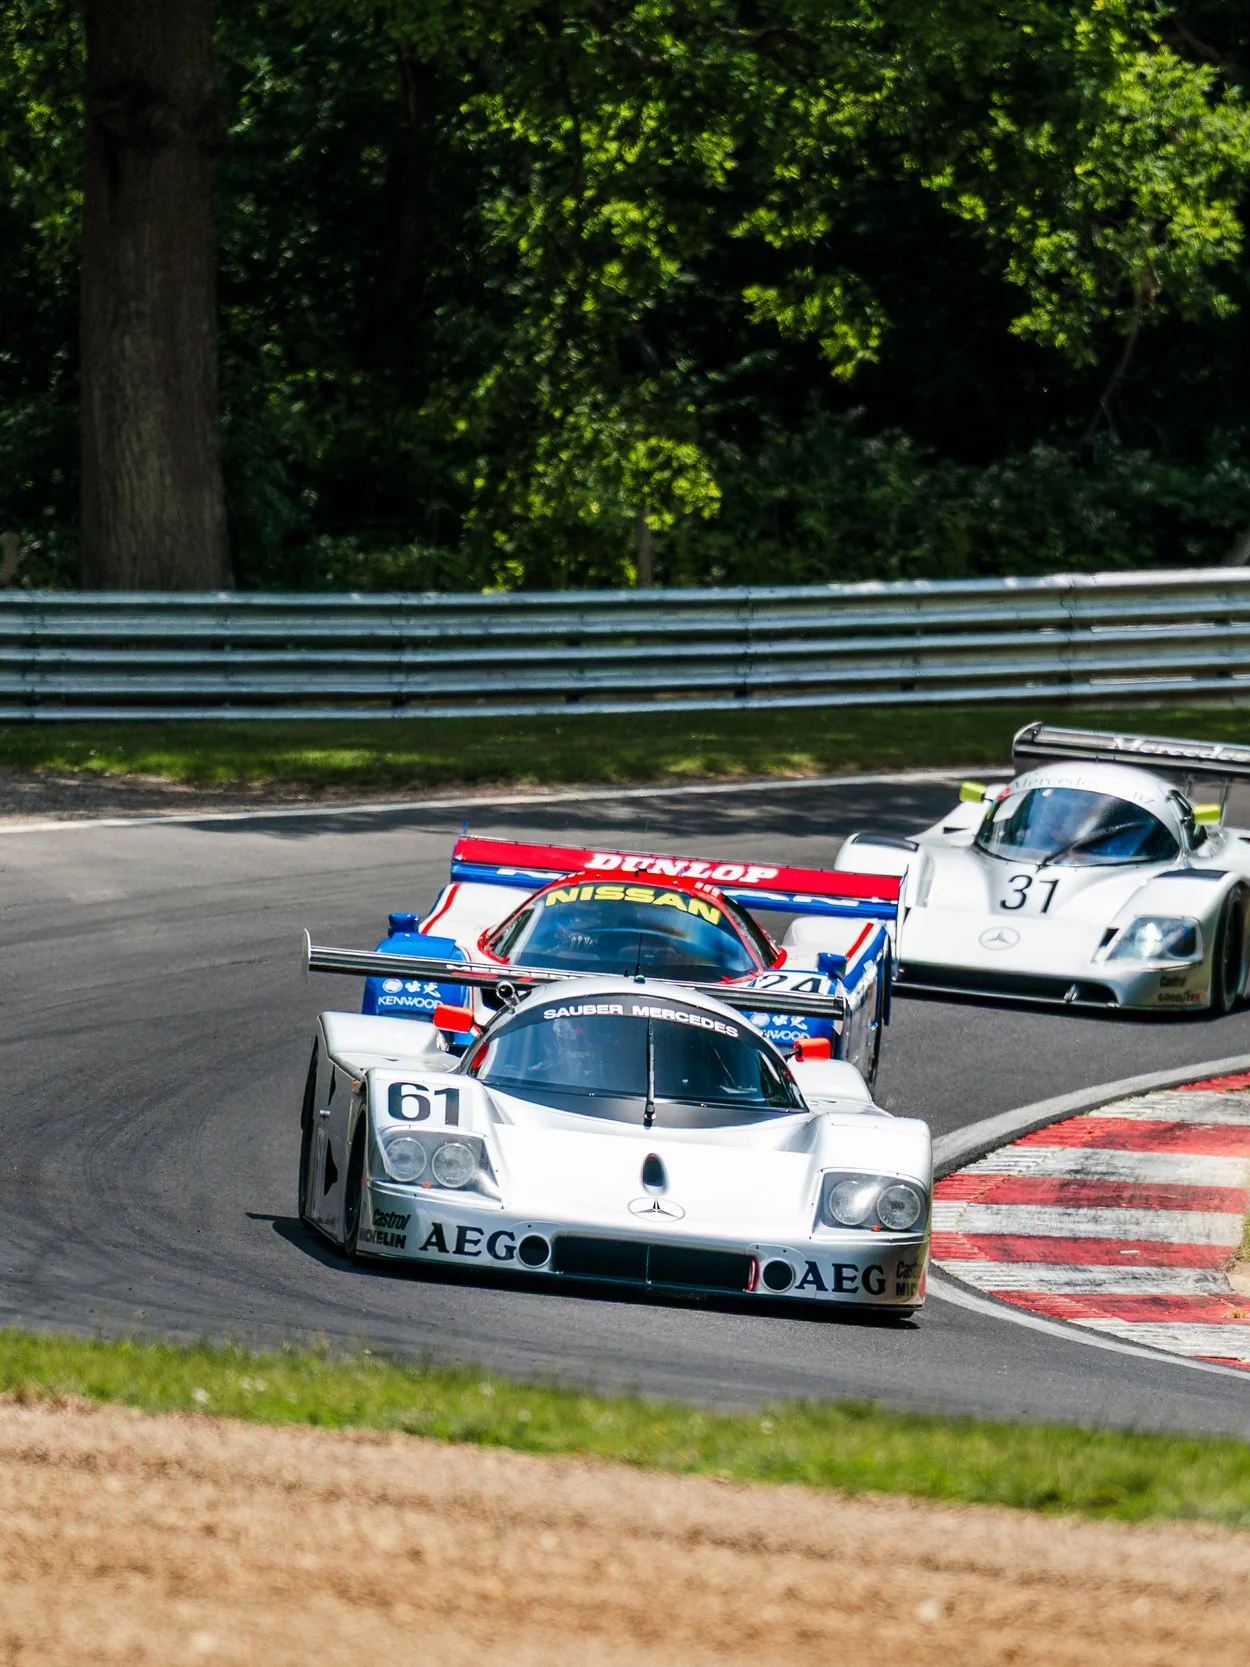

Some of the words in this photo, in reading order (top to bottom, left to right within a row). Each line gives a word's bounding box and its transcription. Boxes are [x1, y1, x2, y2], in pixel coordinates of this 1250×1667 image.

[584, 853, 779, 883] DUNLOP
[545, 885, 722, 925] NISSAN
[1000, 875, 1060, 913] 31
[544, 1004, 623, 1020] SAUBER
[632, 1005, 739, 1037] MERCEDES
[763, 1029, 811, 1041] NWOOD
[388, 1082, 460, 1126] 61
[372, 1208, 411, 1230] Castrol
[419, 1222, 517, 1260] AEG
[795, 1261, 886, 1295] AEG
